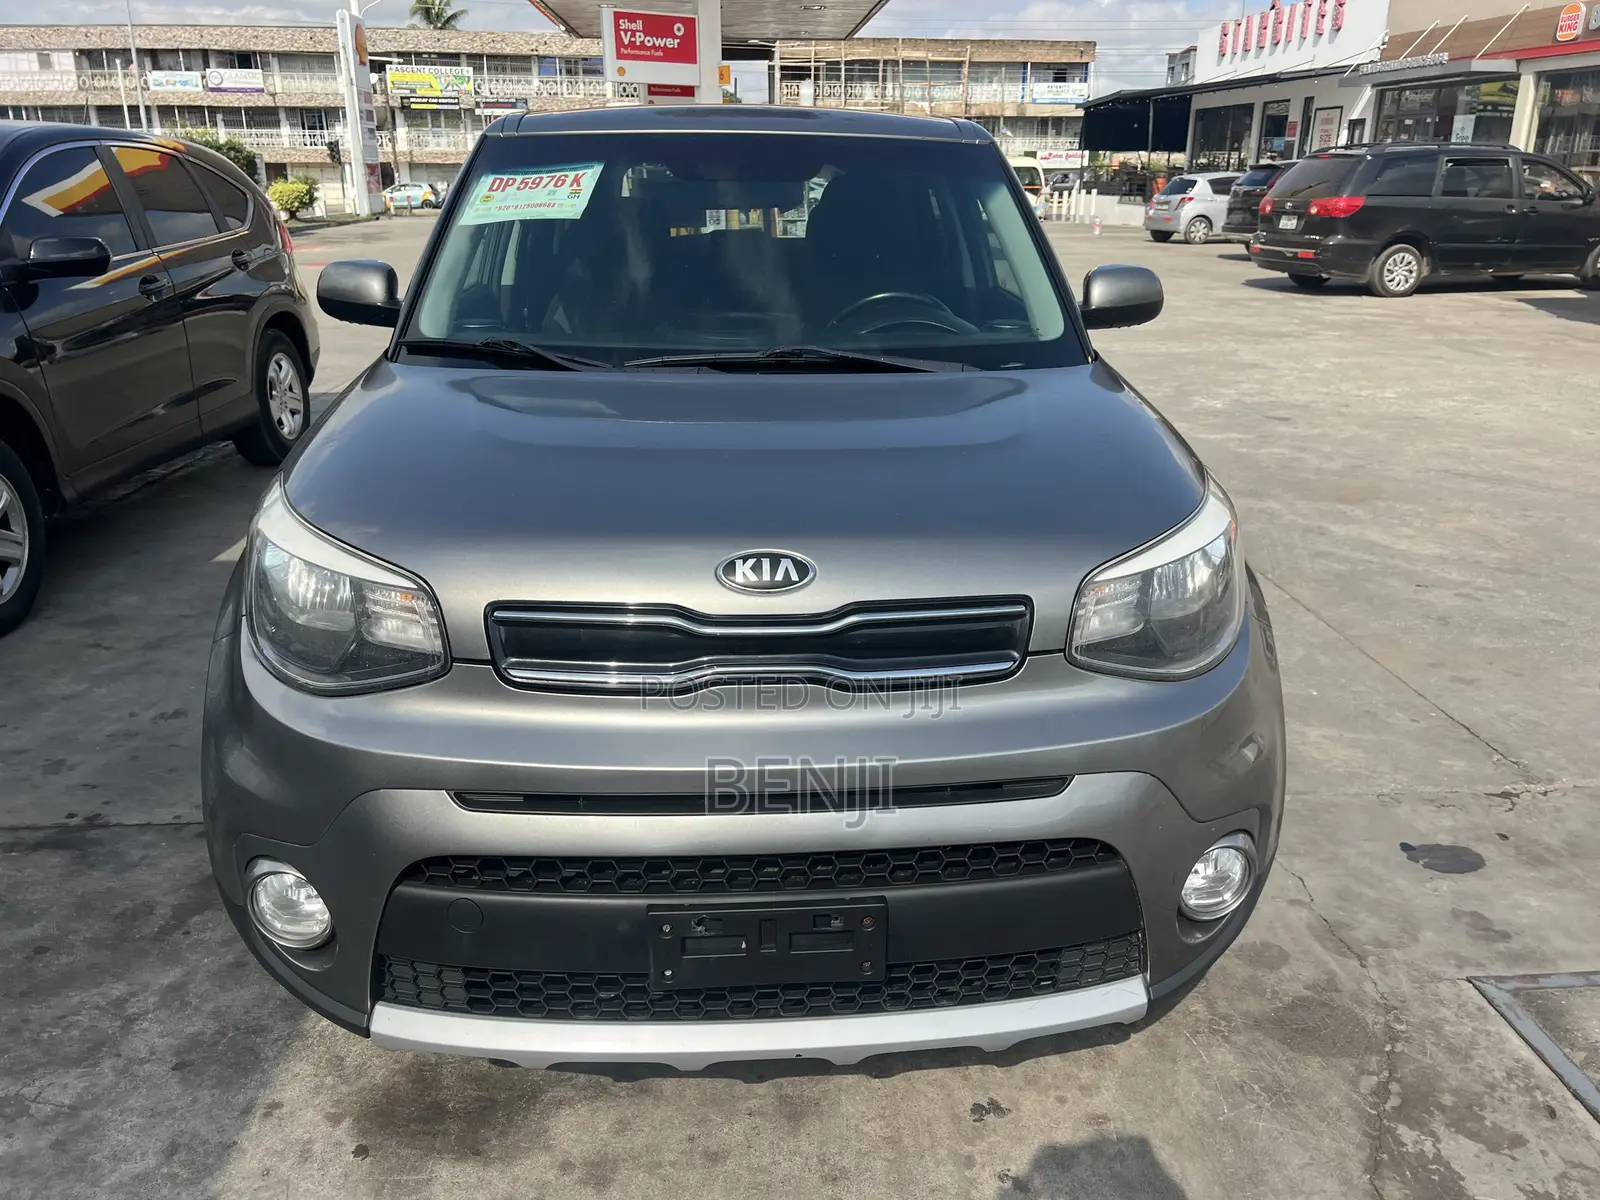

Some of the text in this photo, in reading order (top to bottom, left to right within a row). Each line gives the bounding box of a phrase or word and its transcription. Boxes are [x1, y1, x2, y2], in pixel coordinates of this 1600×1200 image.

[1561, 13, 1580, 23] BURGER
[619, 19, 643, 31] Shell
[1559, 21, 1579, 33] KING
[620, 31, 680, 48] V-Power
[620, 48, 651, 56] Performance
[394, 66, 464, 75] ASCENT COLLEGE
[1319, 134, 1331, 142] SIZE
[487, 172, 587, 193] DP 5976 K
[734, 557, 800, 583] KIA
